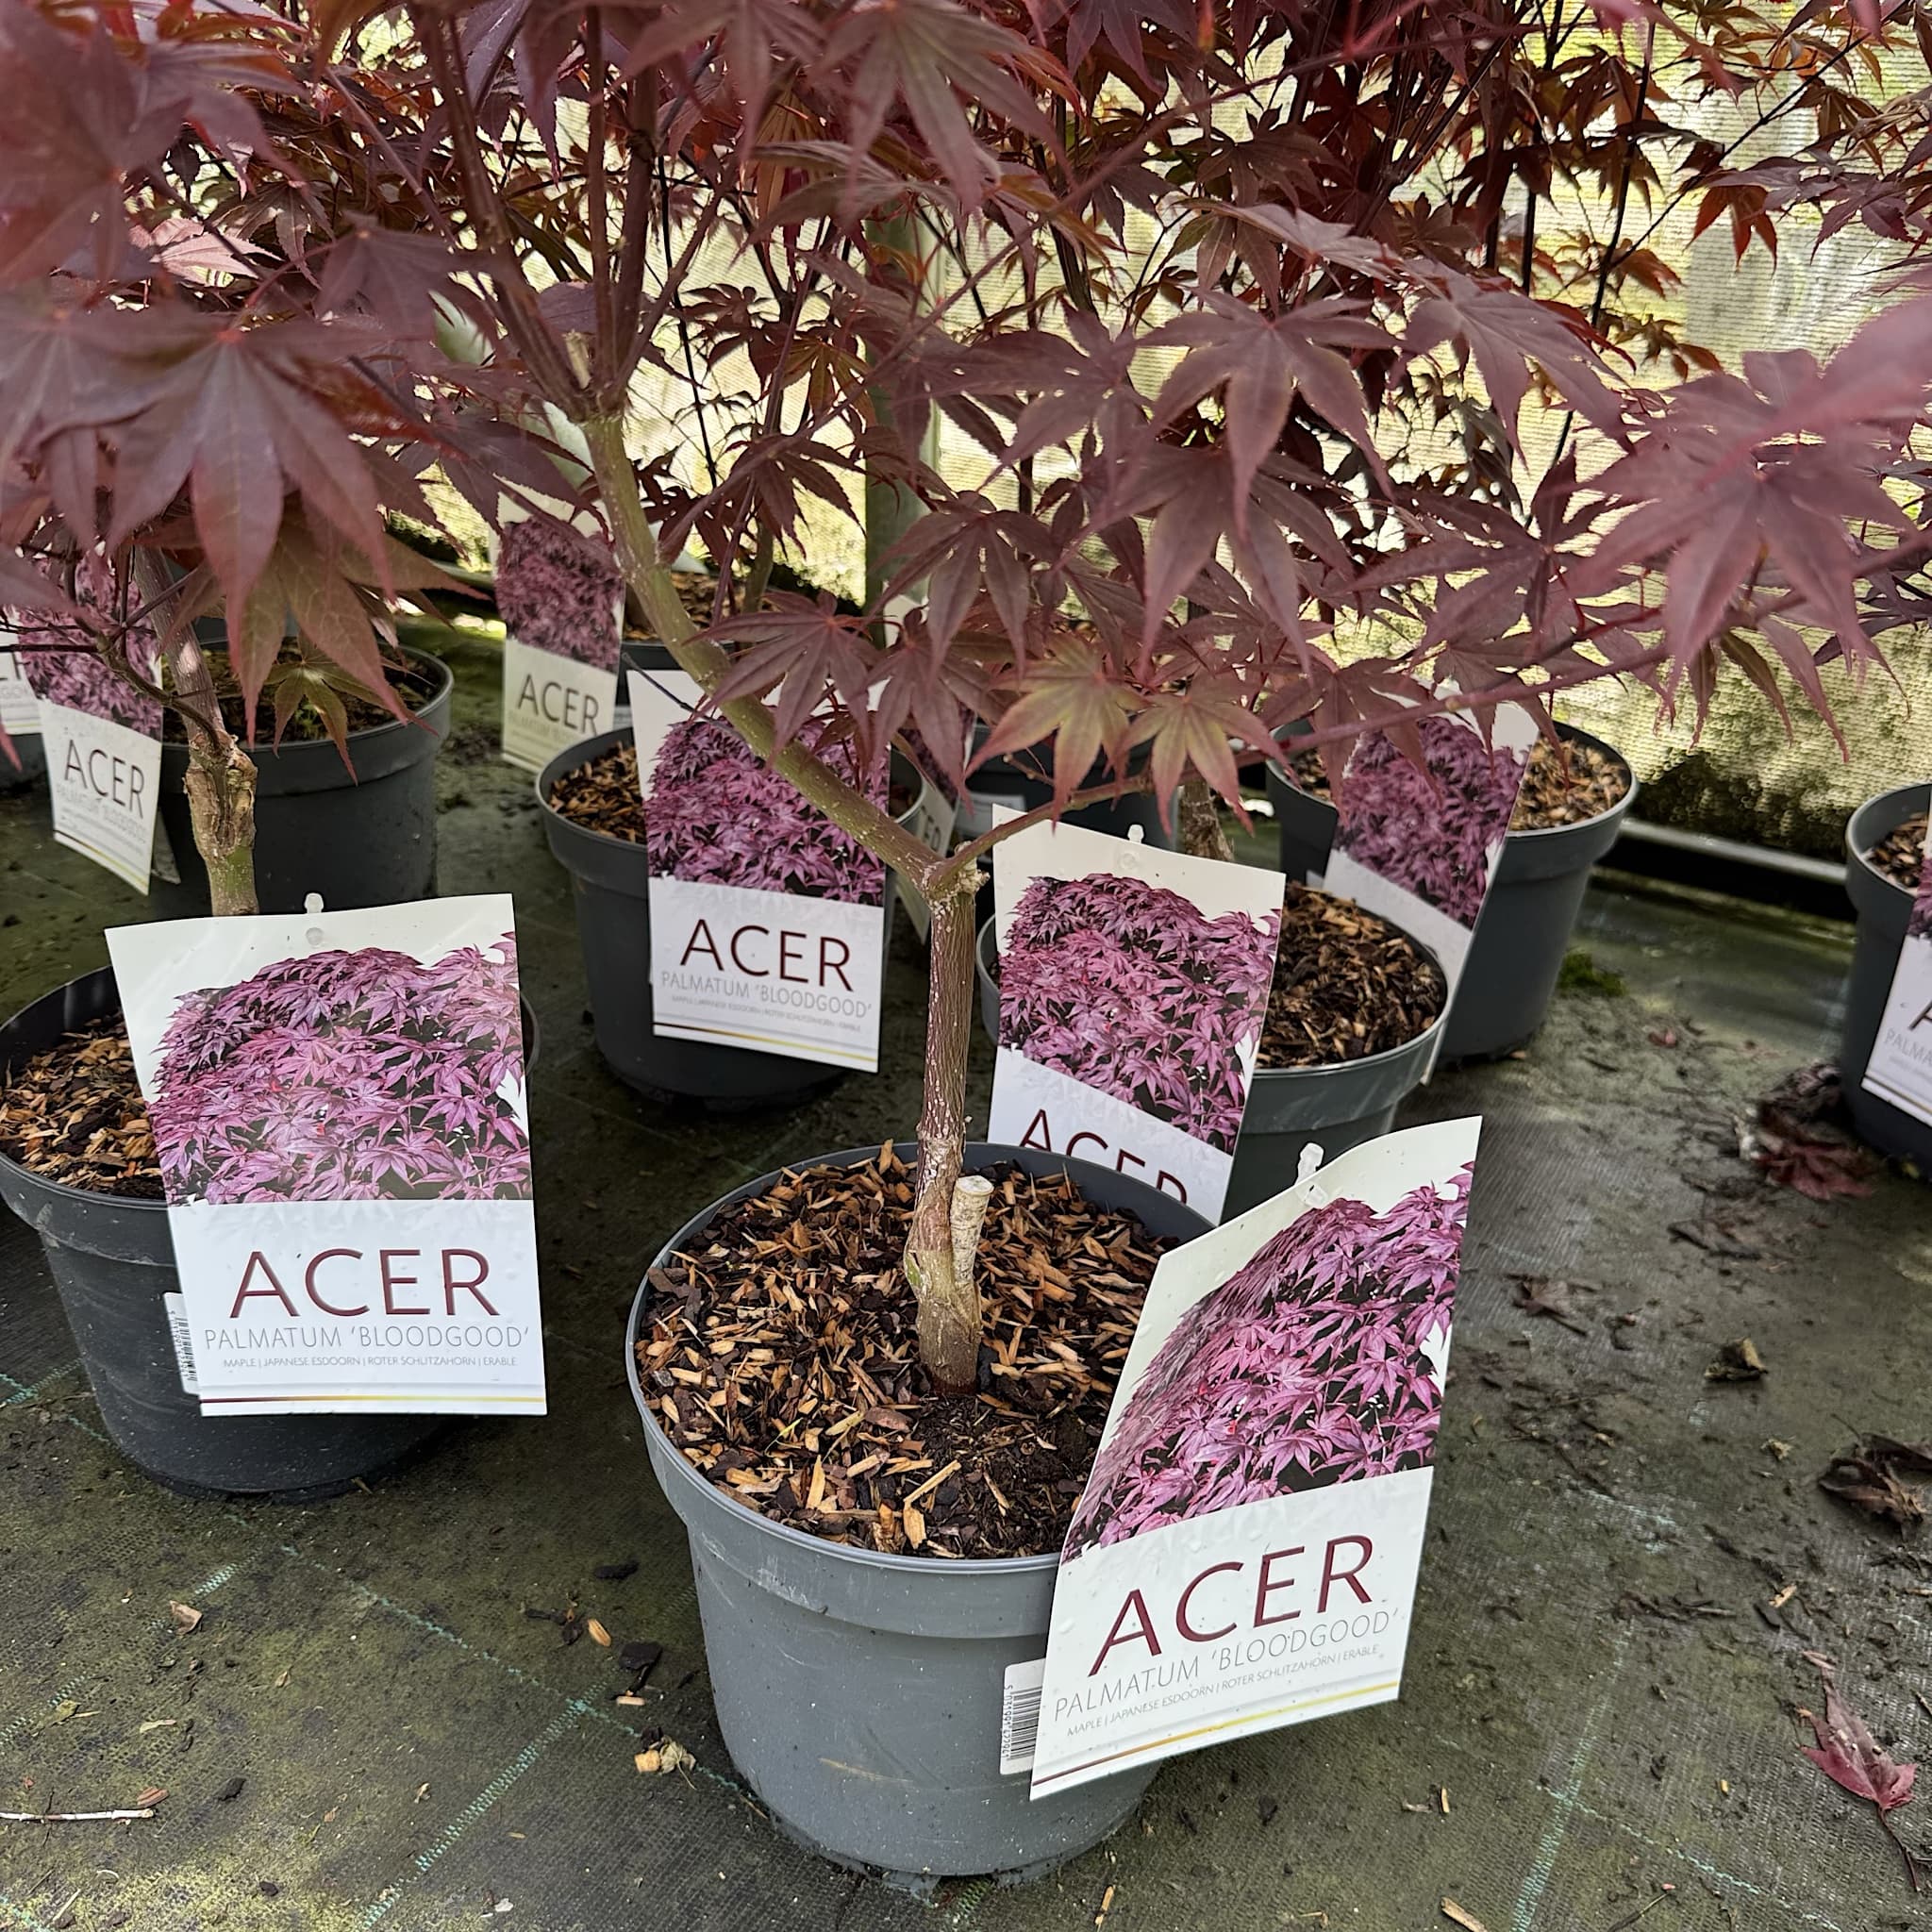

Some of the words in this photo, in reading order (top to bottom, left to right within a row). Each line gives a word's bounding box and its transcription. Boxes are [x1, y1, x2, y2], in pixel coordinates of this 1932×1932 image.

[516, 673, 599, 737] ACER
[64, 740, 144, 819] ACER
[661, 971, 749, 999] PALMATUM
[680, 919, 853, 991] ACER
[230, 1248, 500, 1319] ACER
[206, 1325, 341, 1350] PALMATUM
[351, 1325, 528, 1347] 'BLOODGOOD'
[224, 1357, 257, 1368] MAPLE
[263, 1357, 309, 1367] JAPANESE
[311, 1357, 360, 1366] ESDOORN
[368, 1357, 398, 1366] ROTER
[484, 1357, 516, 1366] ERABLE
[1087, 1534, 1373, 1677] ACER
[1055, 1656, 1199, 1722] PALMATUM
[1211, 1607, 1398, 1671] 'BLOODGOOD'
[1067, 1719, 1102, 1737] MAPLE
[1110, 1698, 1160, 1723] JAPANESE
[1161, 1683, 1214, 1707] ESDOORN
[1221, 1672, 1258, 1690] ROTER
[1343, 1644, 1379, 1660] ERABLE
